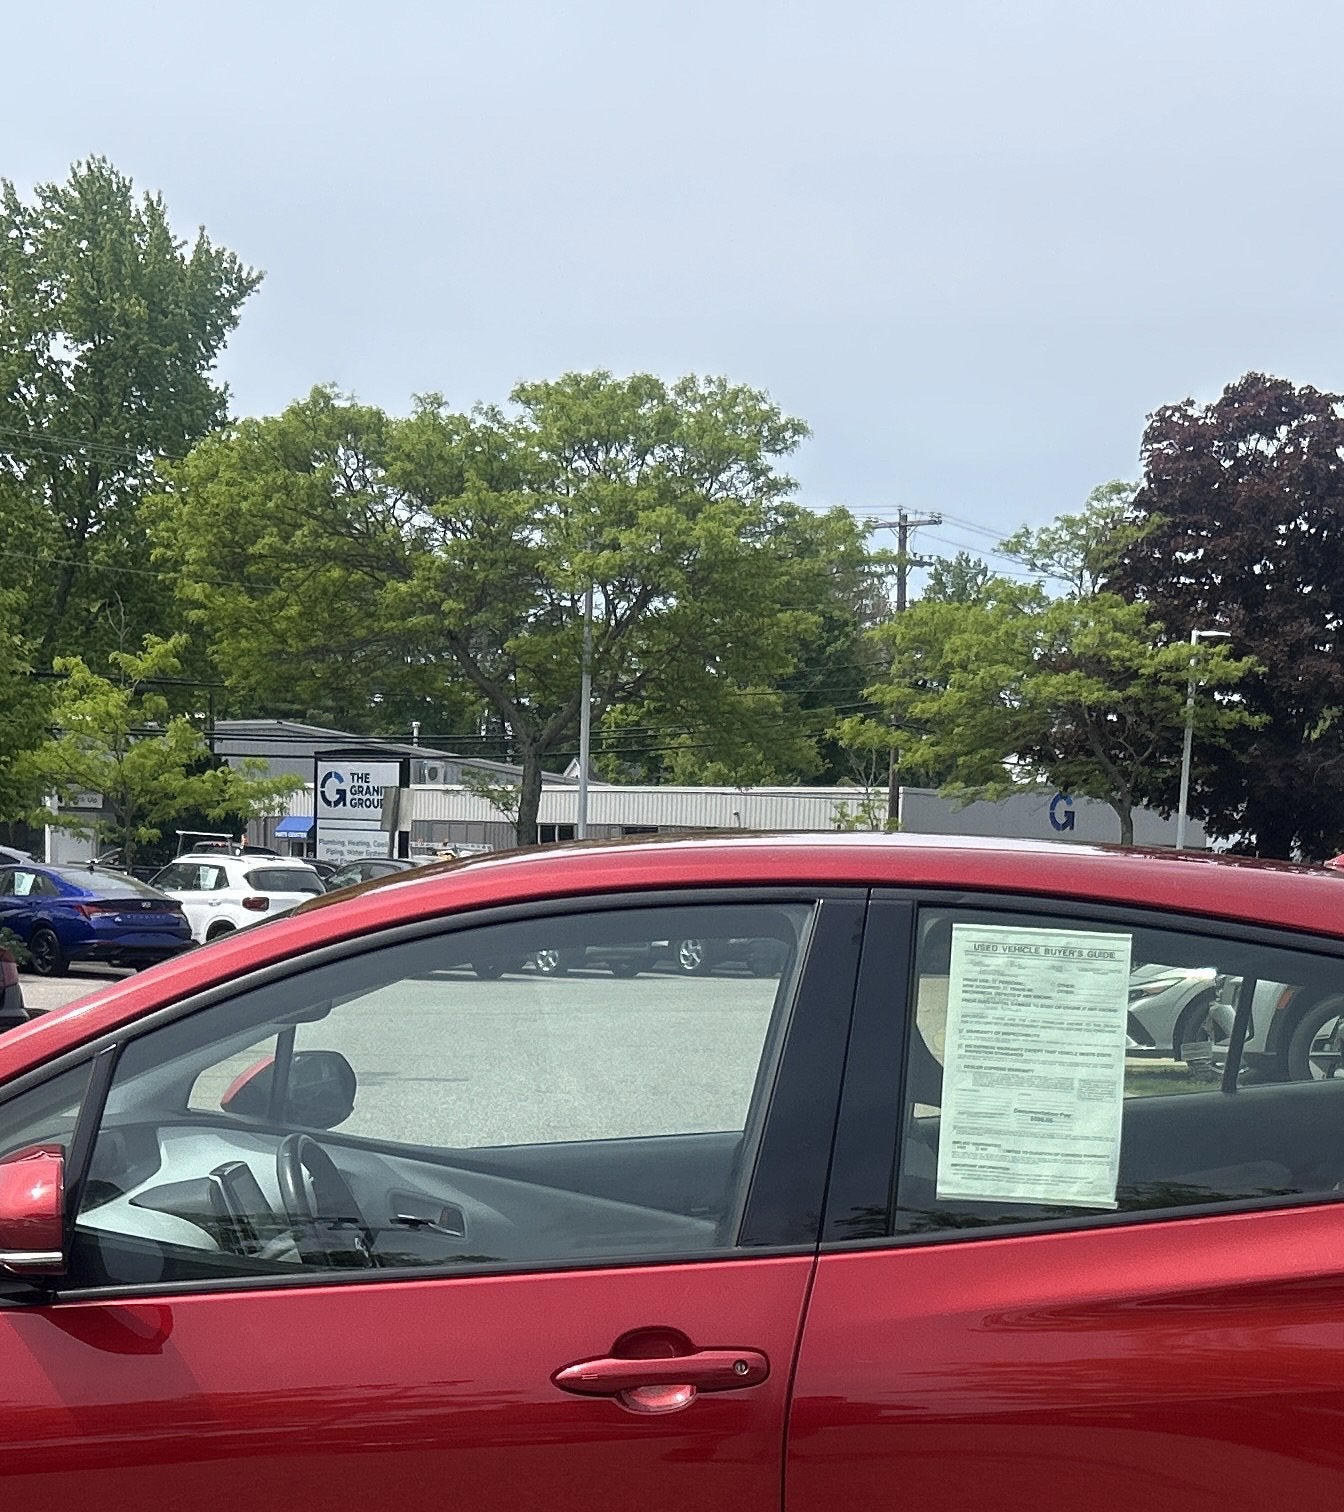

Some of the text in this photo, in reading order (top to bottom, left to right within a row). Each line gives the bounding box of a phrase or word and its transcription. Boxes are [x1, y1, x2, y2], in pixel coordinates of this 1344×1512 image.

[350, 773, 370, 784] THE
[350, 785, 384, 797] GRANI
[973, 943, 1116, 959] USED VEHICLE BUYER'S GUIDE
